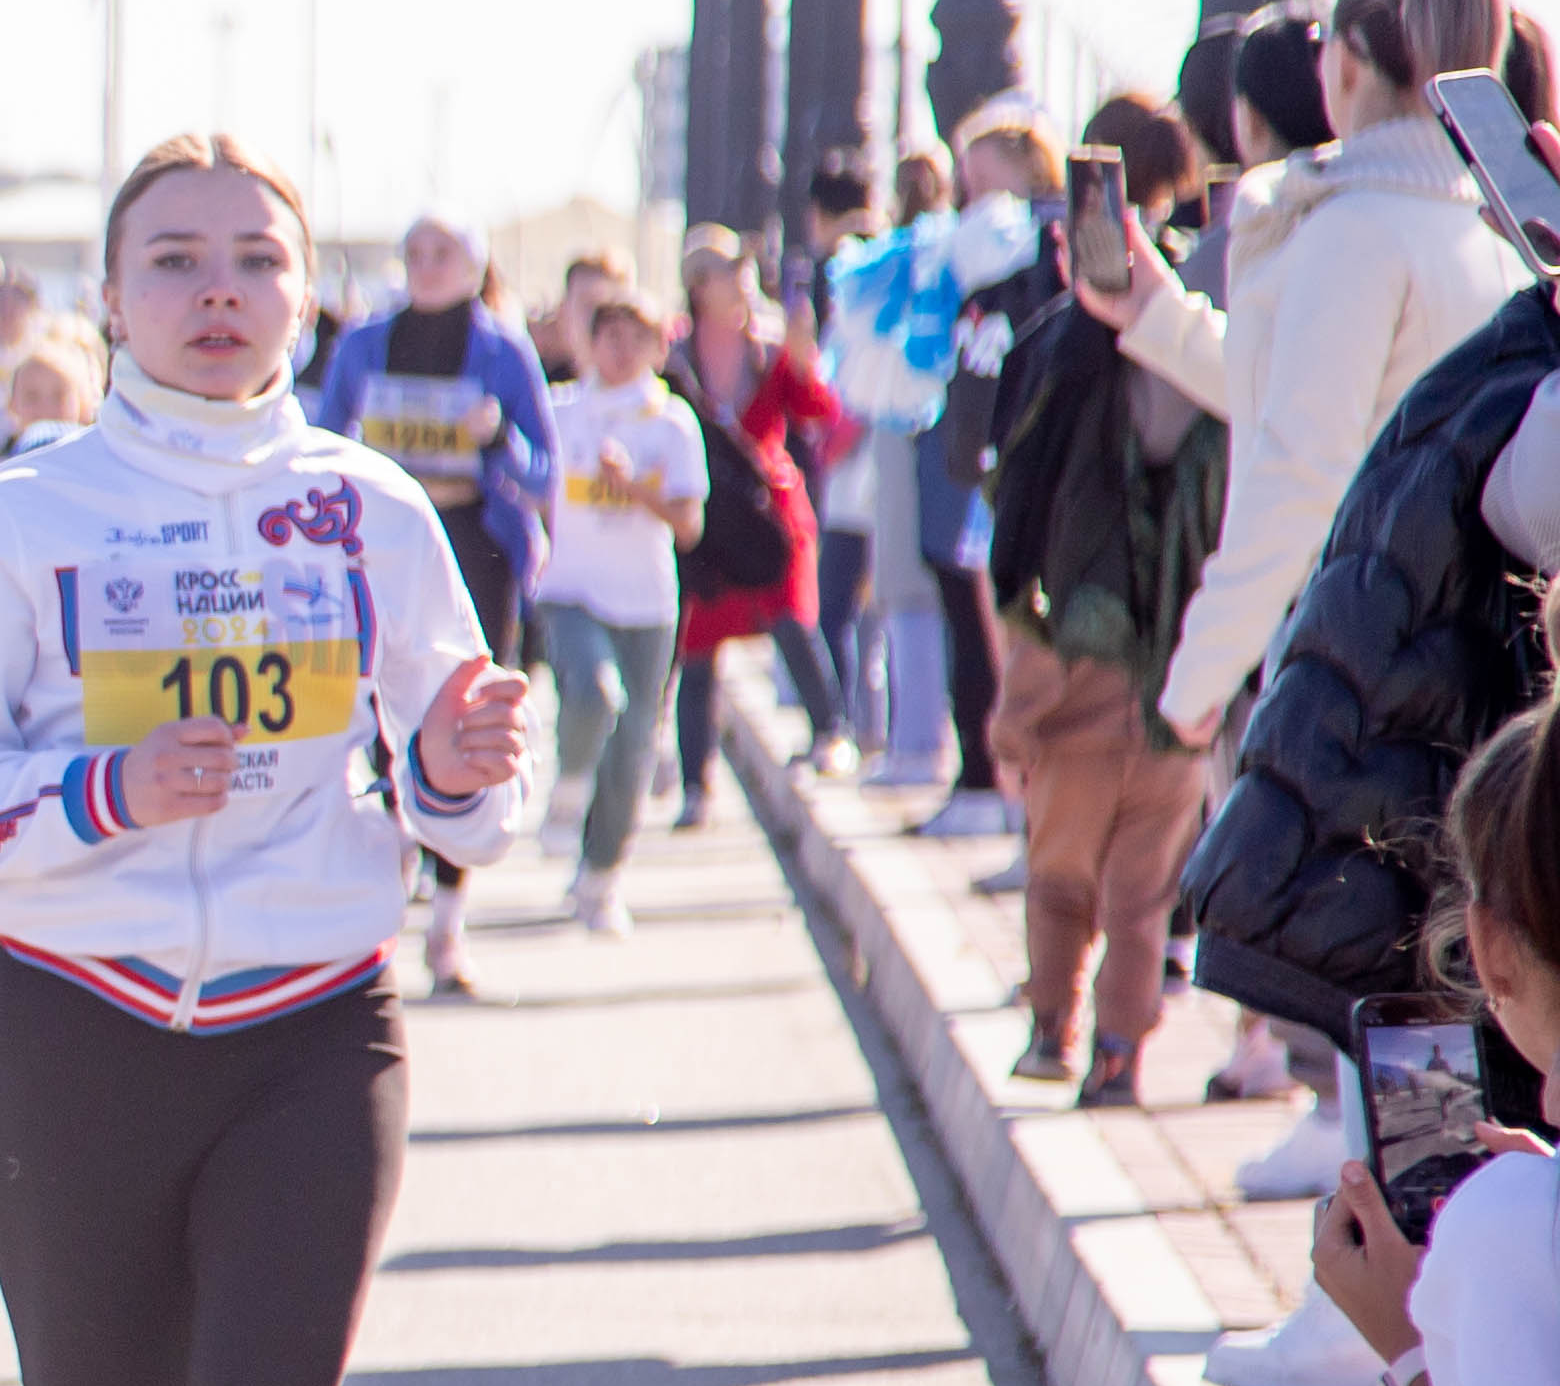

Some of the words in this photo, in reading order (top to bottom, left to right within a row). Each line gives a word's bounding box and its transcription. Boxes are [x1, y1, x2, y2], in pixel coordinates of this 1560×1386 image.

[175, 570, 241, 591] КРОСС
[176, 589, 265, 614] НАЦИИ
[182, 616, 269, 645] 2024
[162, 651, 295, 732] 103
